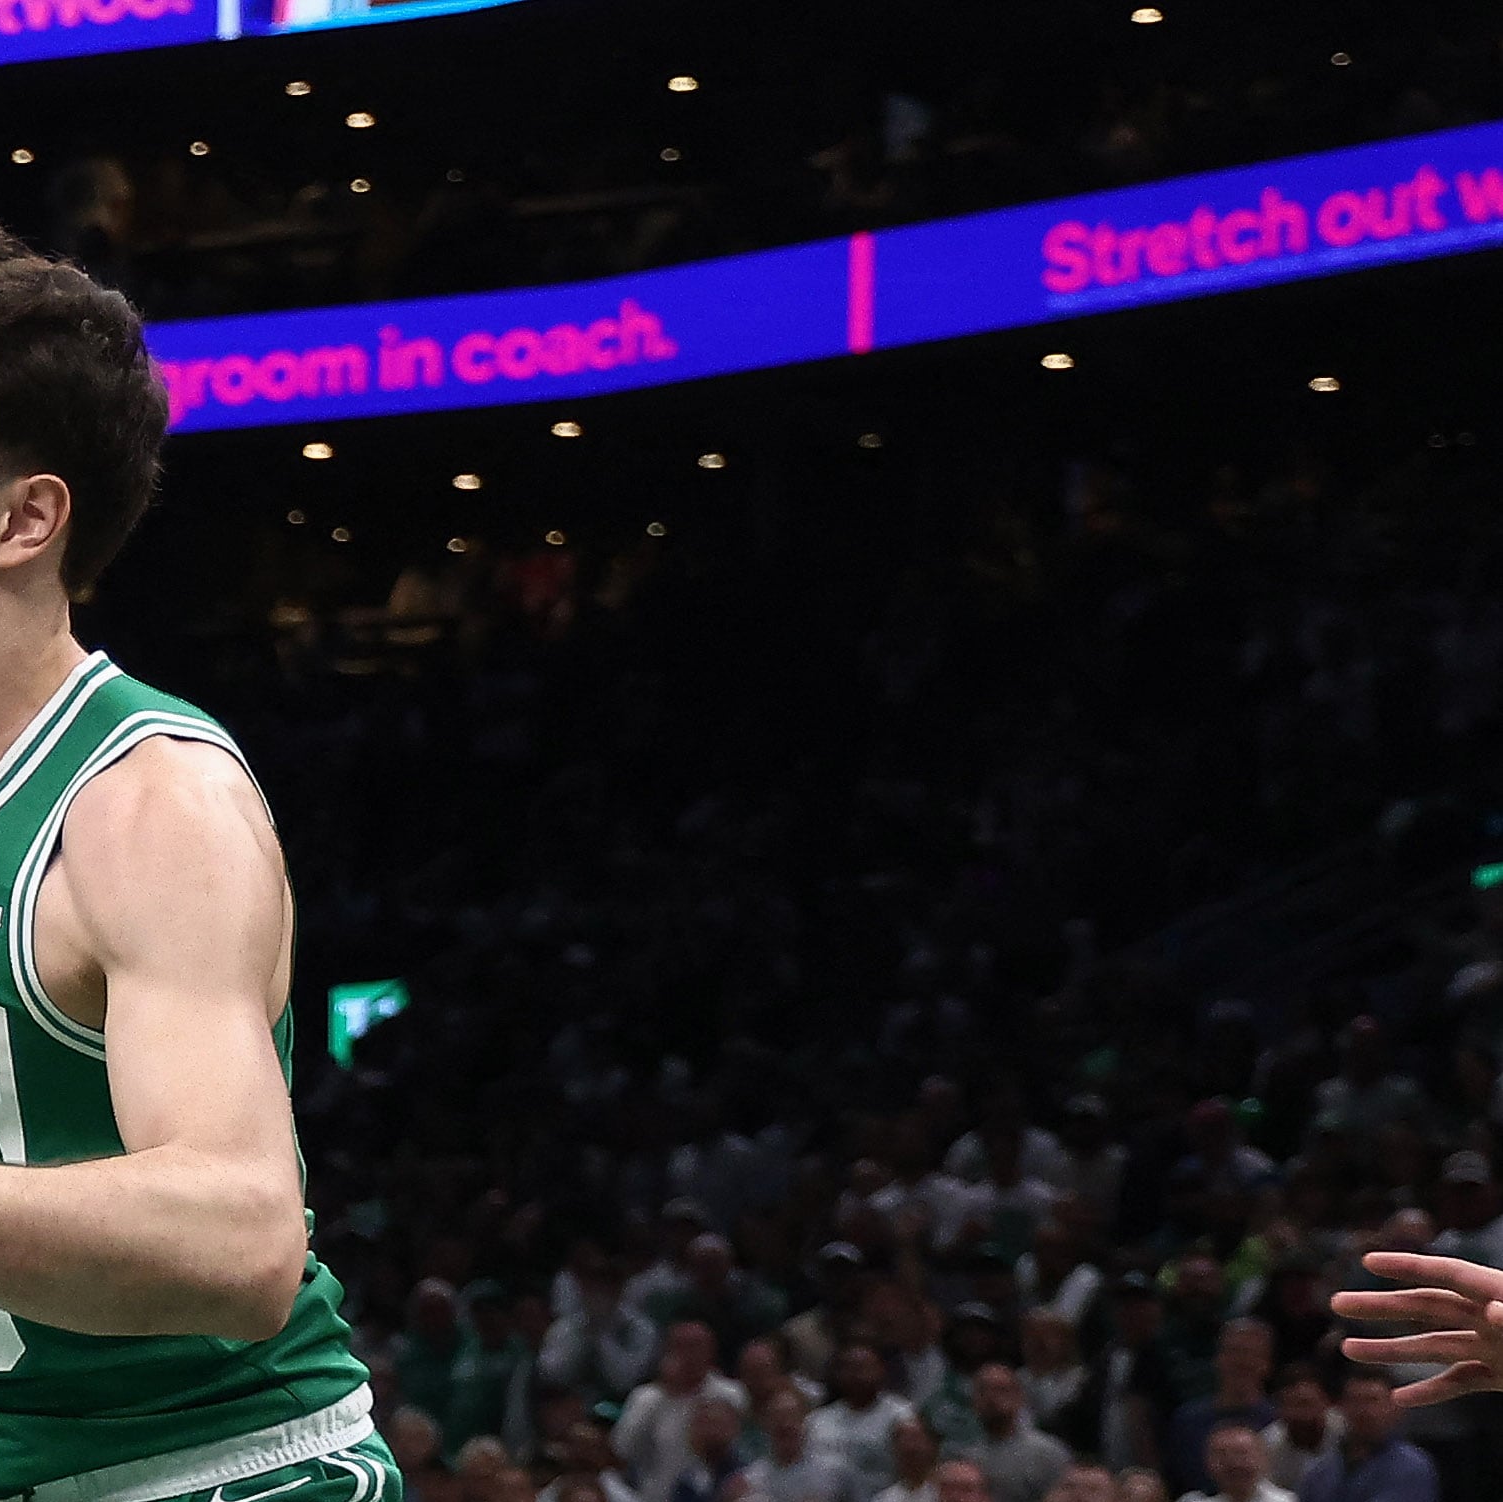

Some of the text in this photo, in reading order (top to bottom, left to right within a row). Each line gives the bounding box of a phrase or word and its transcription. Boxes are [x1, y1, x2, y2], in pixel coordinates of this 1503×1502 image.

[1042, 187, 1308, 294] Stretch
[1316, 165, 1447, 248] out
[377, 325, 444, 391] in
